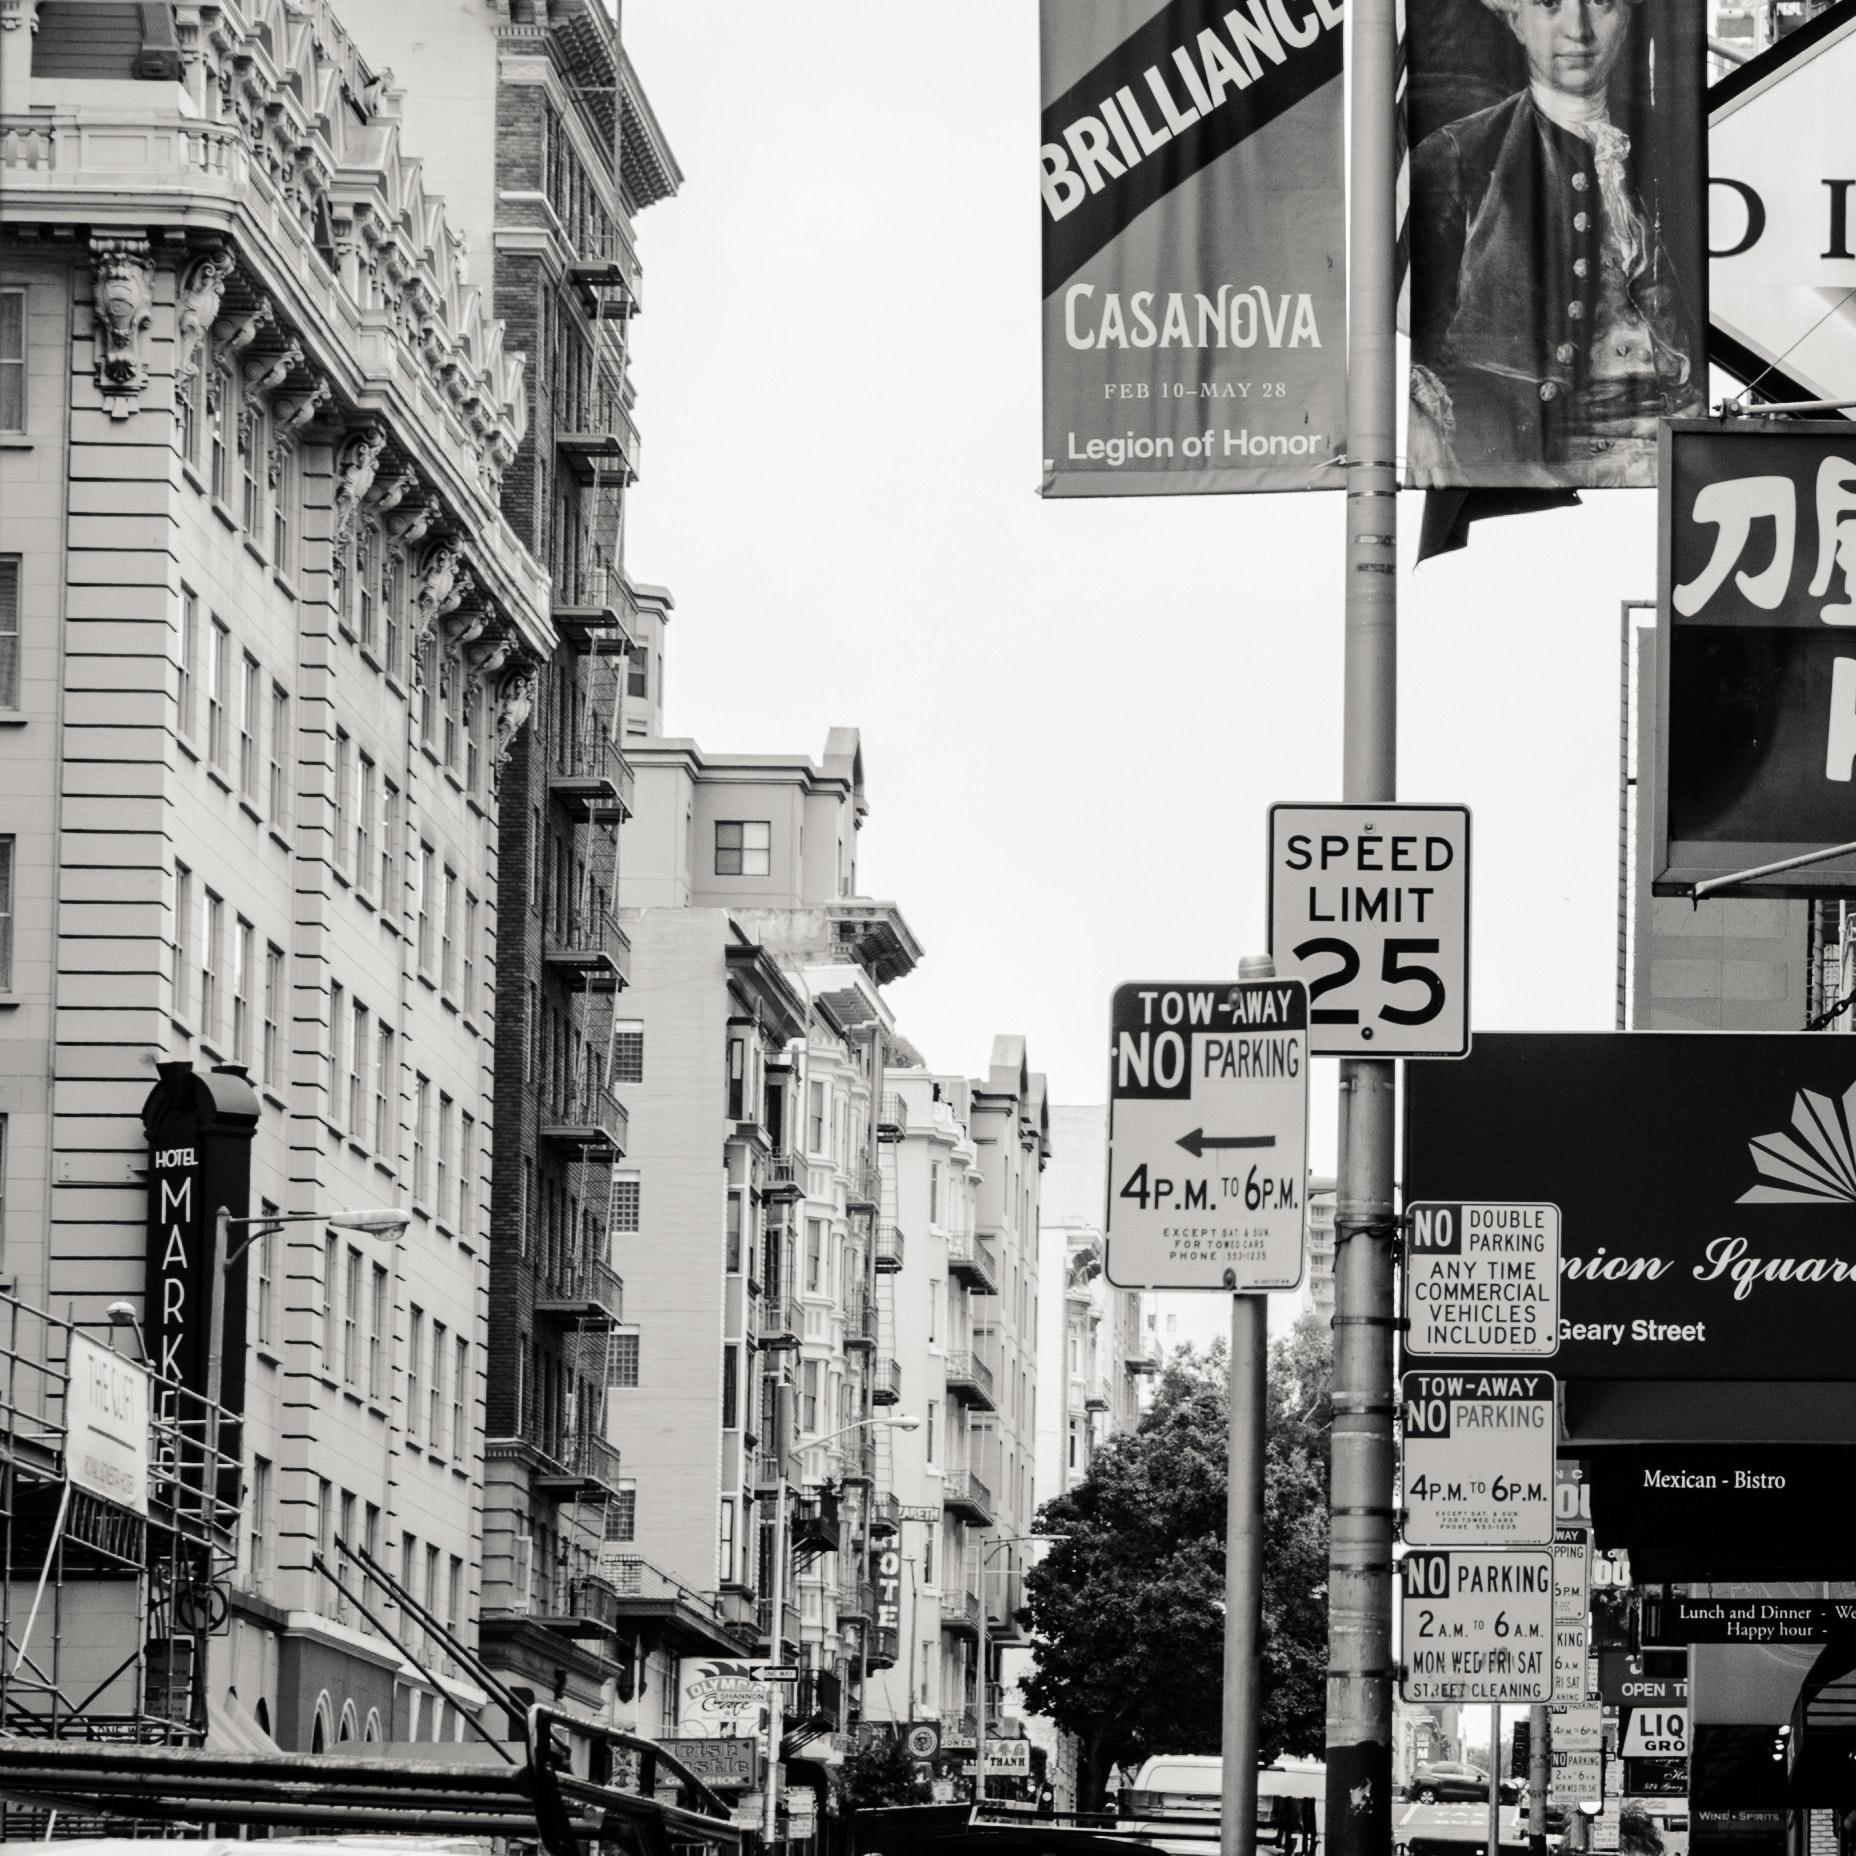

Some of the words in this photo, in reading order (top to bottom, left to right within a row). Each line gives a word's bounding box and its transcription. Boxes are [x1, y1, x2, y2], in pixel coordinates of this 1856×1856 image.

[1064, 283, 1323, 350] CASANOVA
[1103, 383, 1135, 400] FEB
[1263, 382, 1287, 399] 28
[1066, 431, 1175, 466] Legion
[1182, 431, 1216, 461] of
[1223, 428, 1322, 459] Honor
[1284, 834, 1455, 872] SPEED
[1308, 886, 1435, 923] LIMIT
[1291, 937, 1447, 1026] 25
[1138, 990, 1293, 1026] TOW-AWAY
[1117, 1030, 1187, 1090] NO
[1203, 1037, 1299, 1079] PARKING
[154, 1147, 199, 1168] HOTEL
[1221, 1177, 1240, 1198] TO
[1163, 1228, 1217, 1238] EXCEPT
[1414, 1209, 1453, 1248] NO
[1469, 1210, 1545, 1229] DOUBLE
[1174, 1240, 1201, 1249] FOR
[1469, 1233, 1545, 1253] PARKING
[1169, 1251, 1217, 1261] PHONE
[1430, 1261, 1478, 1280] ANY
[1487, 1261, 1536, 1280] TIME
[1415, 1282, 1551, 1302] COMMERCIAL
[1429, 1304, 1537, 1324] VEHICLES
[1427, 1325, 1537, 1345] INCLUDED
[1557, 1316, 1625, 1346] Geary
[1630, 1318, 1706, 1343] Street
[1418, 1376, 1540, 1397] TOW-AWAY
[1407, 1399, 1447, 1433] NO
[1455, 1404, 1546, 1429] PARKING
[1470, 1481, 1487, 1494] TO
[1643, 1469, 1718, 1489] Mexican
[1733, 1470, 1787, 1490] Bistro
[1408, 1556, 1447, 1596] NO
[1457, 1564, 1549, 1594] PARKING
[1680, 1604, 1720, 1620] Lunch
[1729, 1604, 1756, 1620] and
[1761, 1604, 1813, 1620] Dinner
[1473, 1619, 1485, 1631] TO
[1726, 1621, 1774, 1640] Happy
[1779, 1621, 1814, 1637] hour
[1413, 1650, 1446, 1675] MON
[1487, 1650, 1512, 1675] FRI
[1517, 1650, 1544, 1675] SAT
[1470, 1683, 1542, 1699] CLEANING
[1621, 1683, 1666, 1697] OPEN
[1639, 1714, 1685, 1739] LIQ
